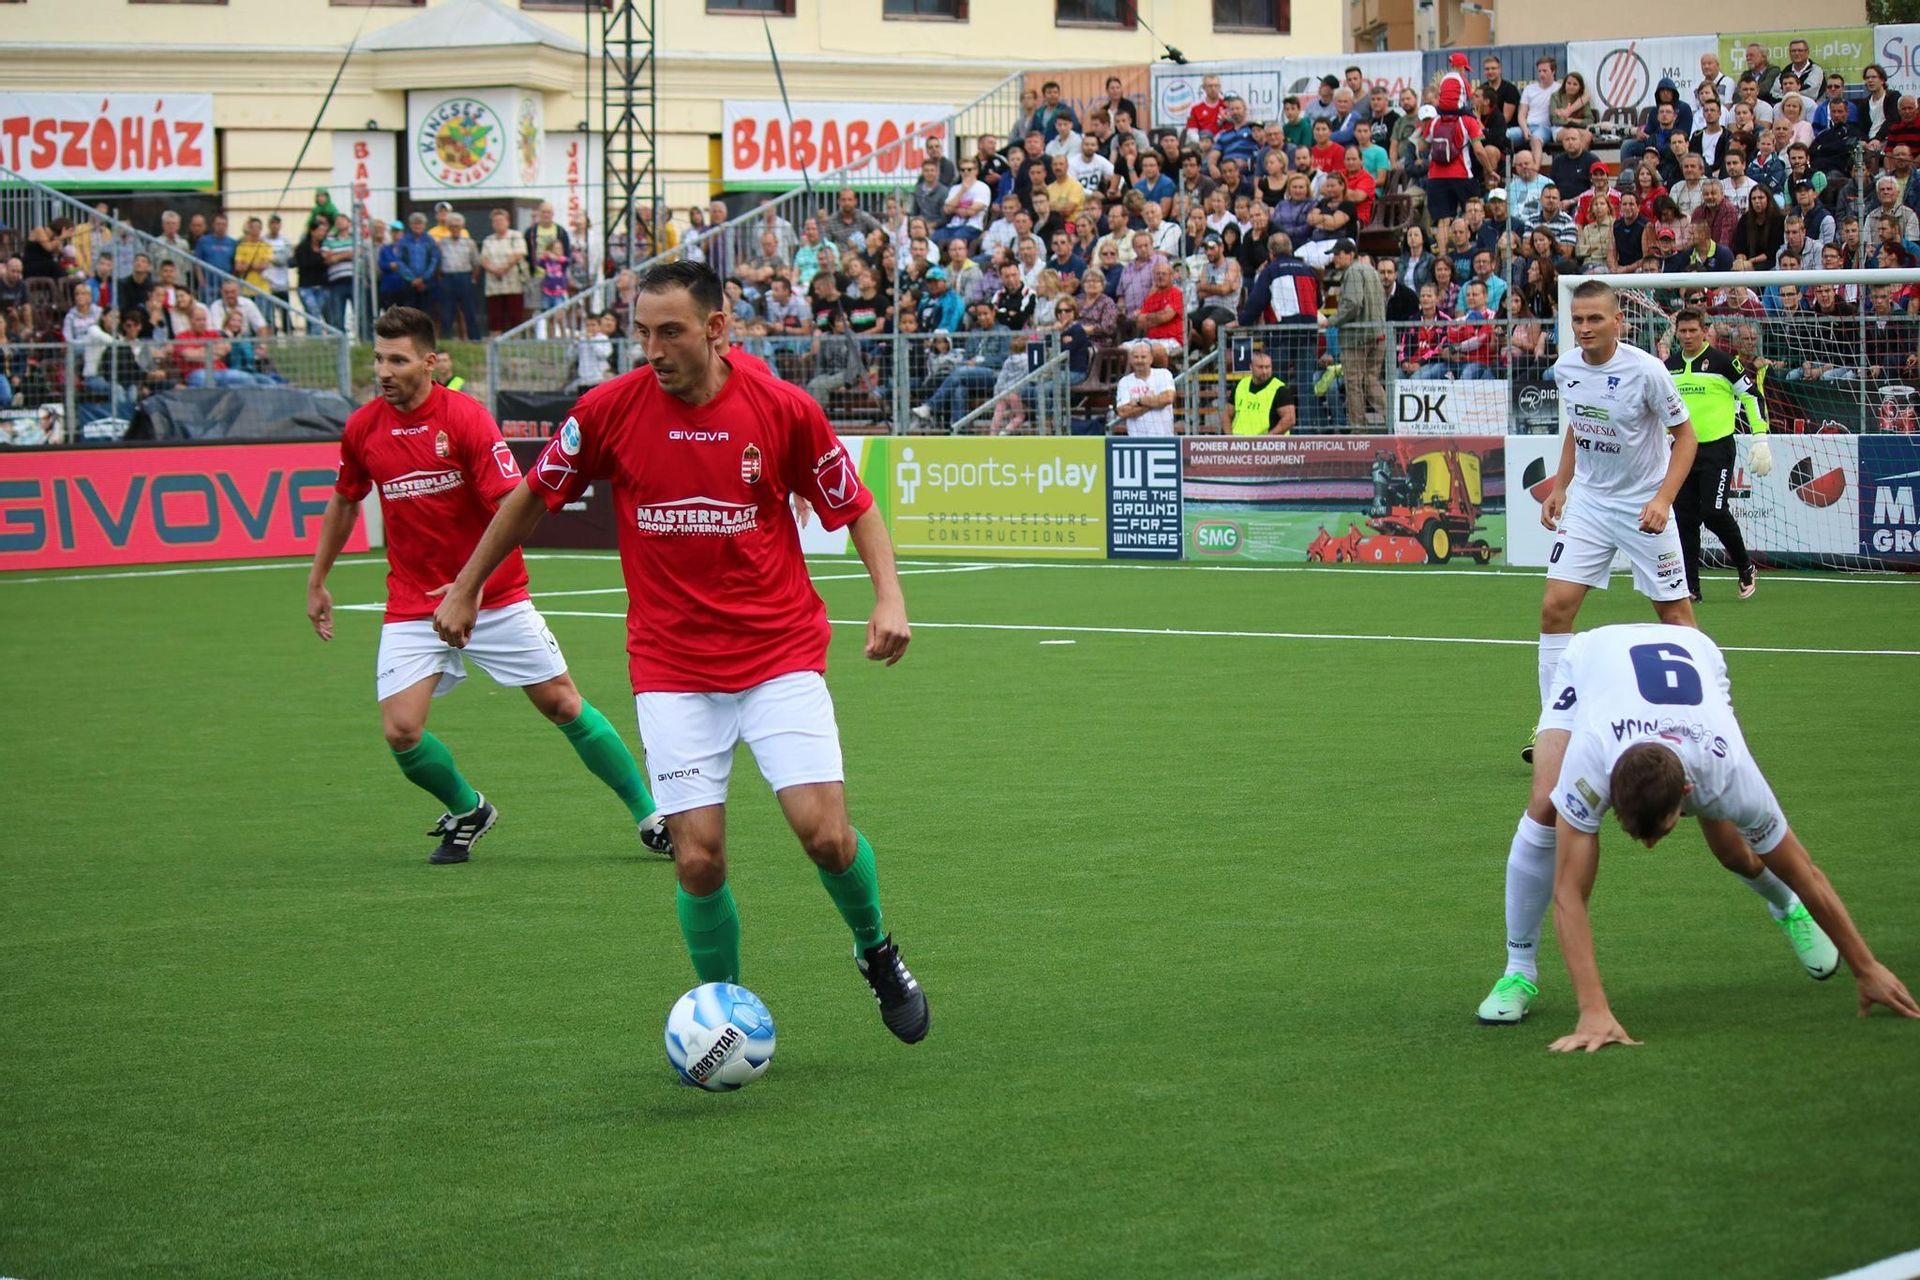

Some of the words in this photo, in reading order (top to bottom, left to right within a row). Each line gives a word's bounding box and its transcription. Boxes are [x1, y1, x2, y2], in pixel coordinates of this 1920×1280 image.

[1662, 67, 1680, 78] M4
[0, 97, 204, 172] TSZÓHÁZ
[422, 102, 486, 153] KINCSES
[1399, 394, 1447, 423] DK
[391, 425, 429, 436] GIVOVA
[668, 430, 729, 441] GIVOVA
[1190, 441, 1228, 451] PIONEER
[1230, 441, 1250, 451] AND
[1252, 441, 1287, 451] LEADER
[1288, 441, 1297, 451] IN
[1299, 441, 1345, 451] ARTIFICIAL
[1348, 440, 1371, 451] TURF
[1190, 455, 1253, 465] MAINTENANCE
[1255, 455, 1306, 465] EQUIPMENT
[927, 457, 1097, 493] sports+play
[1112, 450, 1177, 487] WE
[382, 470, 463, 494] MASTERPLAST
[1715, 468, 1728, 510] GIVOVA
[1113, 490, 1147, 500] MAKE
[1152, 490, 1177, 500] THE
[1113, 503, 1177, 515] GROUND
[1873, 486, 1920, 525] M
[637, 506, 758, 525] MASTERPLAST
[638, 521, 674, 532] GROUP
[1130, 519, 1160, 530] FOR
[927, 529, 1077, 543] CONSTRUCTIONS
[1113, 533, 1178, 545] WINNERS
[1198, 528, 1237, 546] SMG
[657, 768, 700, 782] GIVOVA
[688, 1027, 739, 1081] DERBYSTAR
